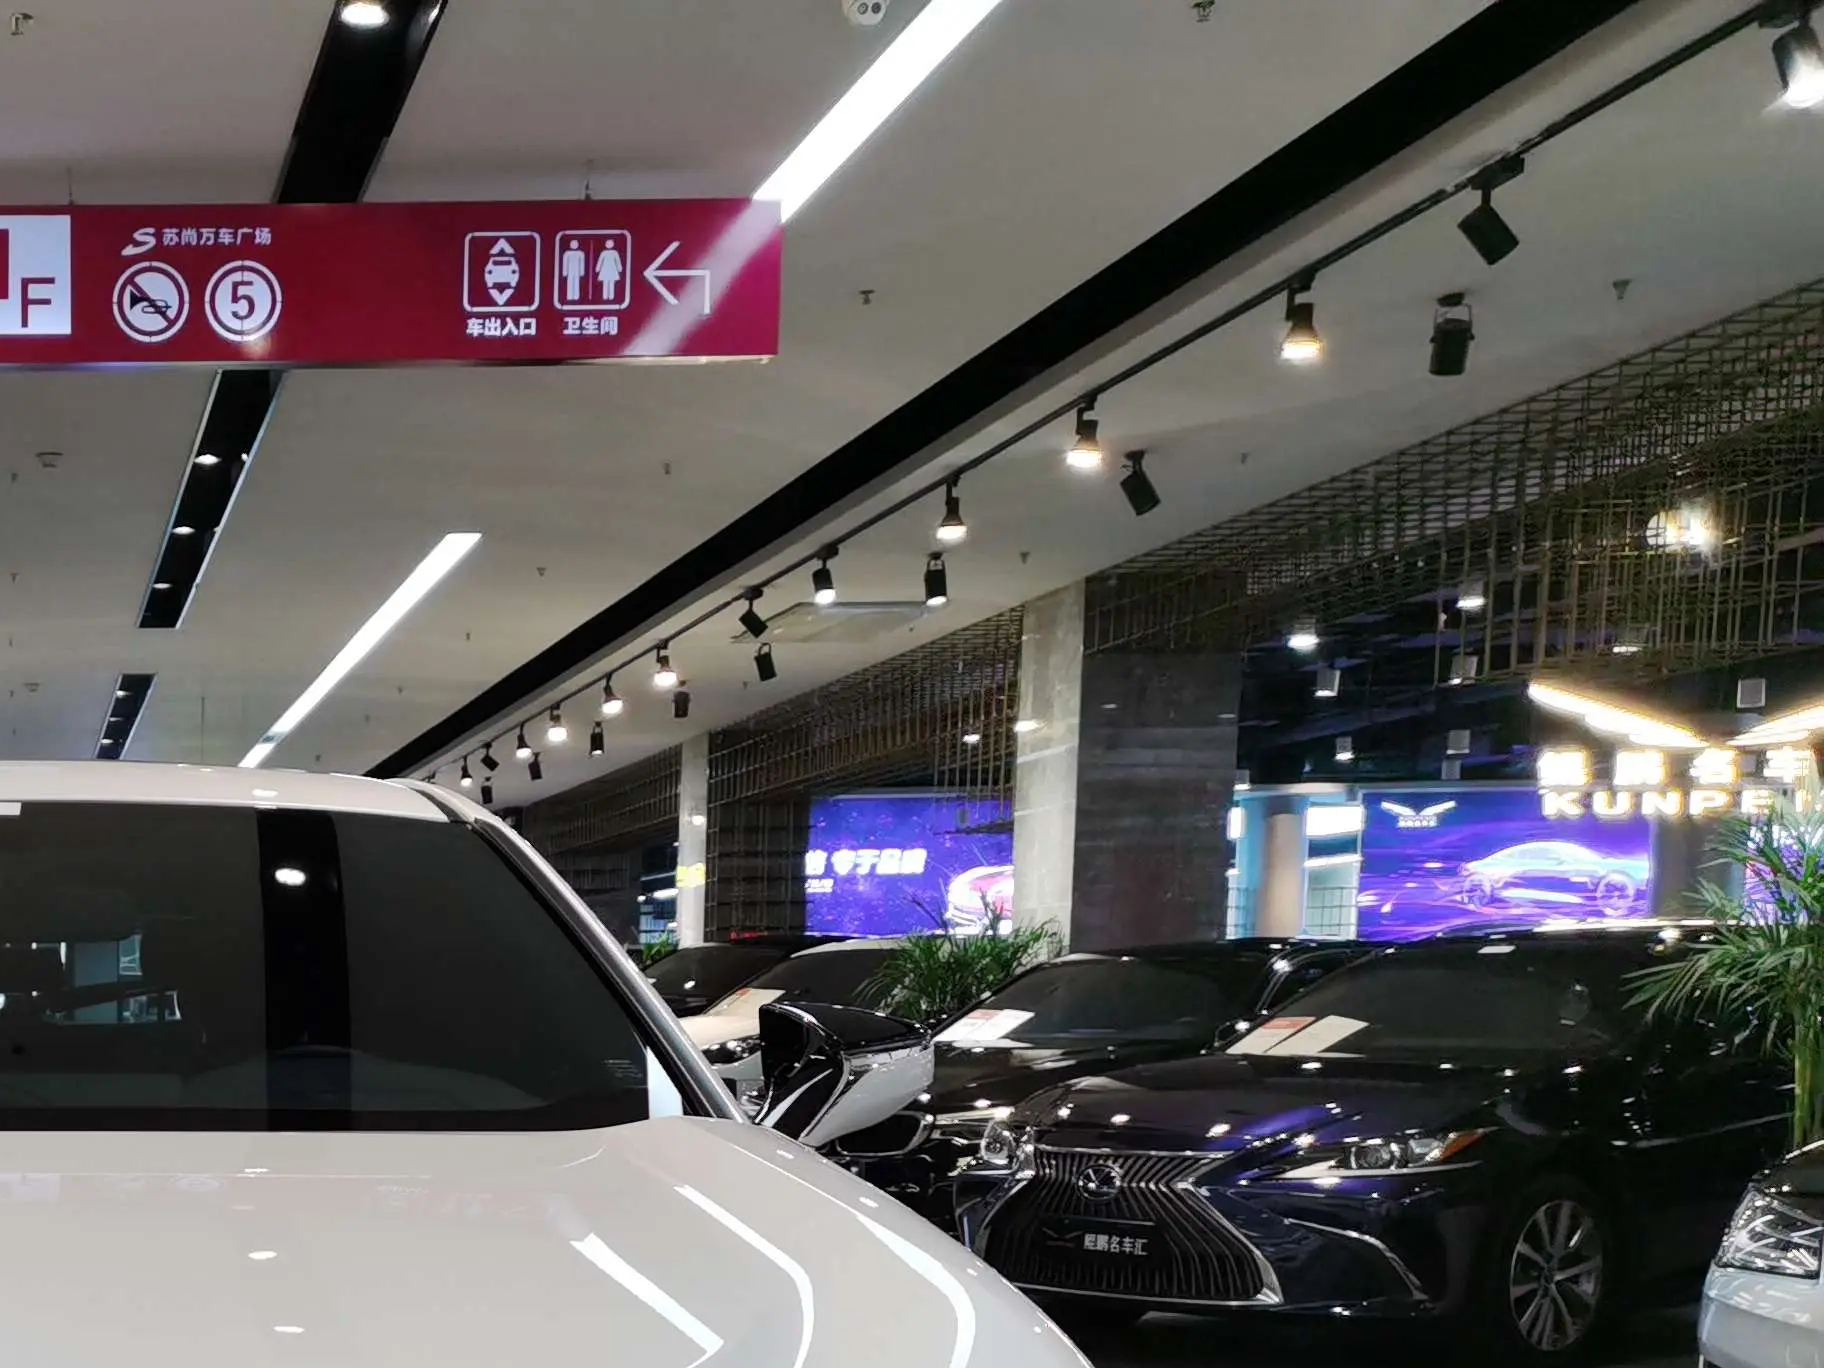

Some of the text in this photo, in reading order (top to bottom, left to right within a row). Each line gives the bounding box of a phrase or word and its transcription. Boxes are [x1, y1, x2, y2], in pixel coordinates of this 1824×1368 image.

[161, 227, 272, 246] 苏尚万车广场
[230, 280, 256, 321] 5
[465, 316, 538, 337] 车出入口
[562, 315, 619, 335] 卫生间
[1083, 1233, 1149, 1256] 鲲鹏名车汇
